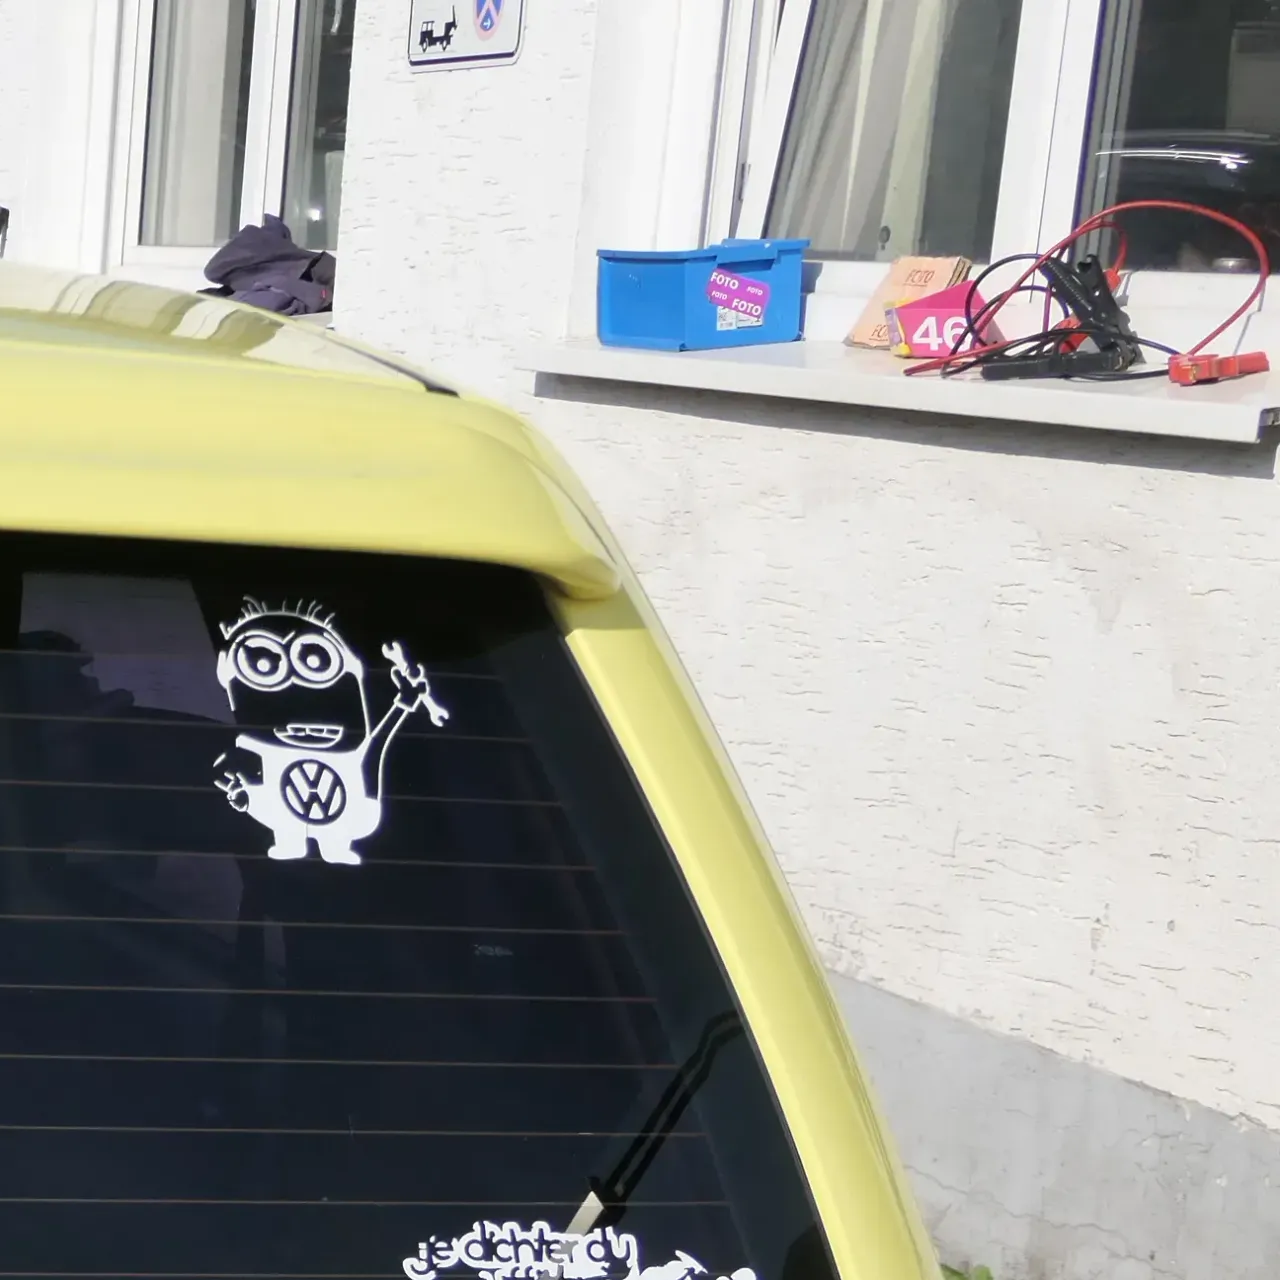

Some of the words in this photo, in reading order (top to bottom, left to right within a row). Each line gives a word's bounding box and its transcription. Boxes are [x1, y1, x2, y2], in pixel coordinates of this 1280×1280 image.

[711, 272, 739, 290] FOTO
[905, 269, 935, 284] FOTO
[711, 290, 728, 300] FOTO
[746, 286, 763, 296] FOTO
[732, 298, 762, 316] FOTO
[912, 316, 974, 352] 46
